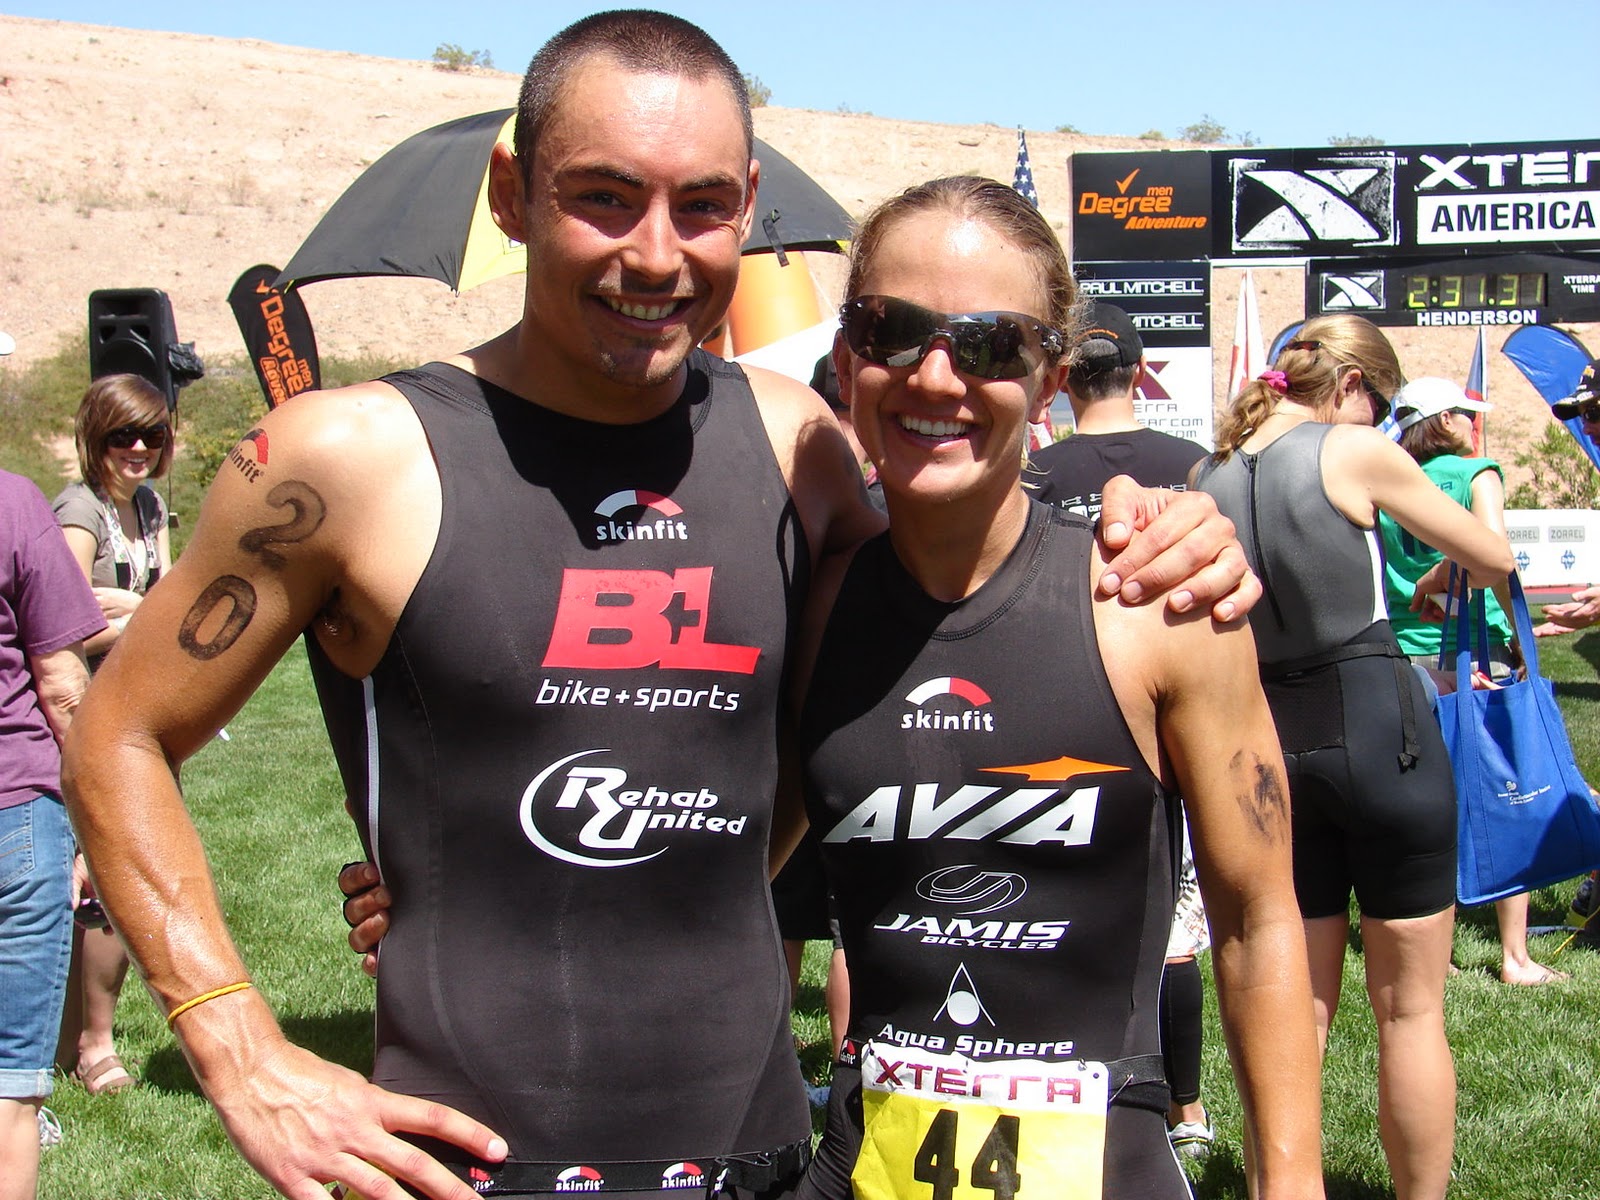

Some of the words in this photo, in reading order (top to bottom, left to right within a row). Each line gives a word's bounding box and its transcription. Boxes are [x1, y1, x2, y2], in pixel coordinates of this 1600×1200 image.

[1147, 186, 1173, 197] men
[1079, 192, 1172, 219] Degree
[1431, 200, 1596, 233] AMERICA
[1125, 216, 1207, 230] Adventure
[1079, 281, 1122, 294] PAUL
[1570, 285, 1595, 293] TIME
[1416, 310, 1537, 326] HENDERSON
[261, 295, 304, 395] Degree
[298, 358, 313, 388] men
[1134, 403, 1178, 413] ERRA
[596, 520, 689, 541] skinfit
[1507, 530, 1538, 540] ZORREL
[1551, 529, 1584, 540] ZORREL
[900, 709, 995, 732] skinfit
[555, 766, 719, 809] Rehab
[822, 782, 1101, 846] AVIA
[578, 808, 748, 849] United
[873, 913, 1071, 941] JAMIS
[920, 935, 1058, 950] BICYCLES
[877, 1023, 945, 1050] Aqua
[954, 1034, 1075, 1057] Sphere
[874, 1055, 1082, 1104] XTERRA
[914, 1108, 1021, 1200] 44
[555, 1178, 602, 1191] skinfit
[662, 1174, 704, 1188] skinfit
